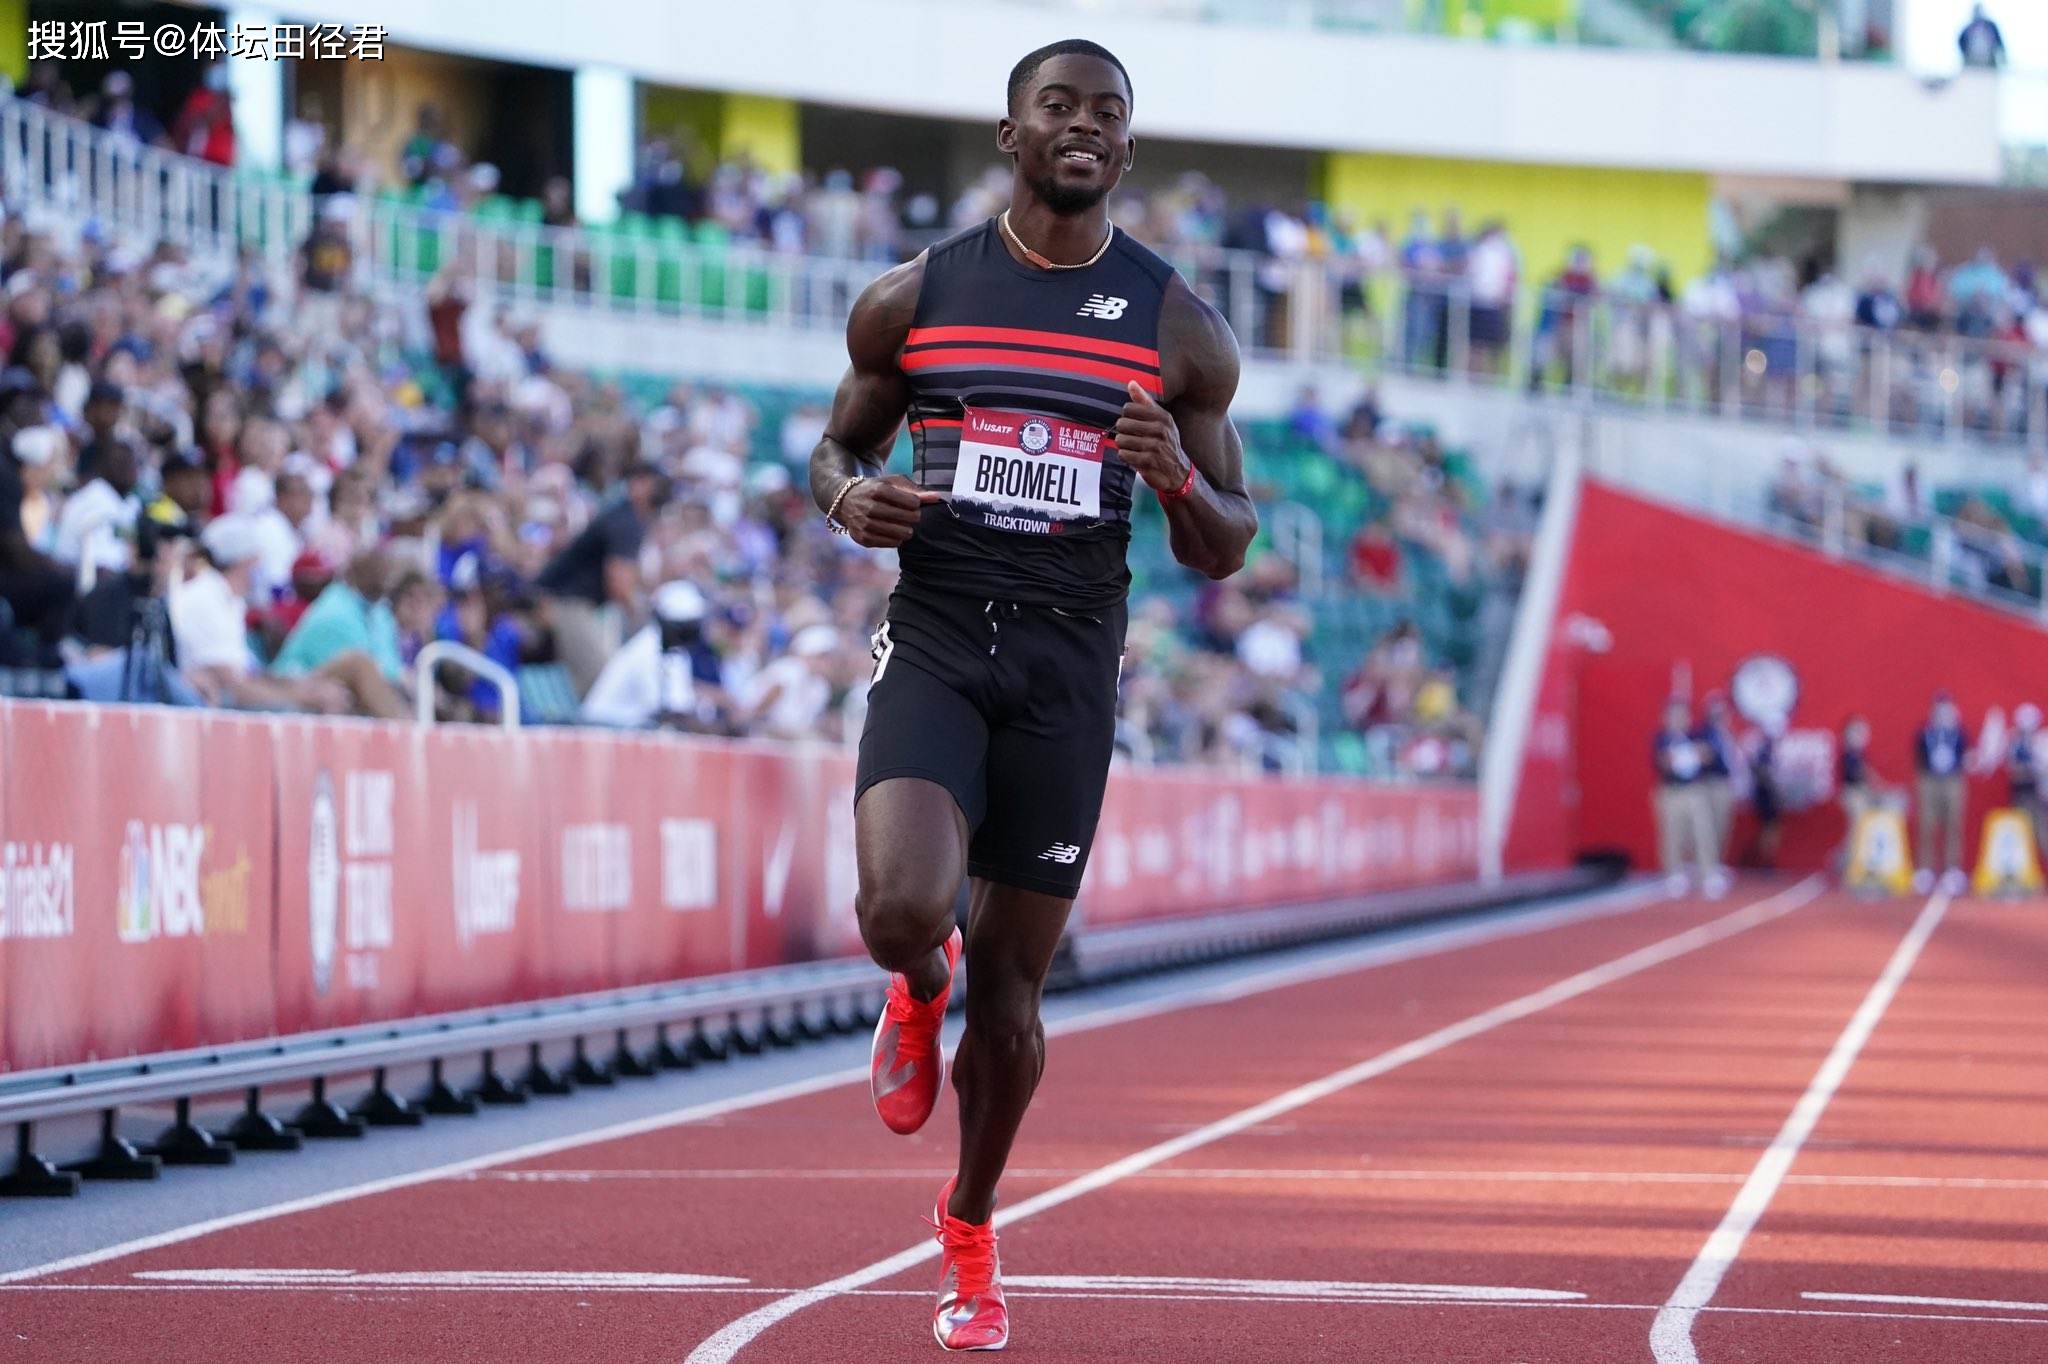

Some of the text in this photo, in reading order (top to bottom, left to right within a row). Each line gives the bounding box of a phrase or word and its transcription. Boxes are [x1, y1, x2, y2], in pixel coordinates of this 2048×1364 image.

[983, 423, 1013, 434] USATF
[1059, 426, 1101, 443] U.S. OLYMPIC
[1058, 437, 1076, 450] TEAM
[1076, 440, 1098, 453] TRIALS
[975, 454, 1081, 506] BROMELL
